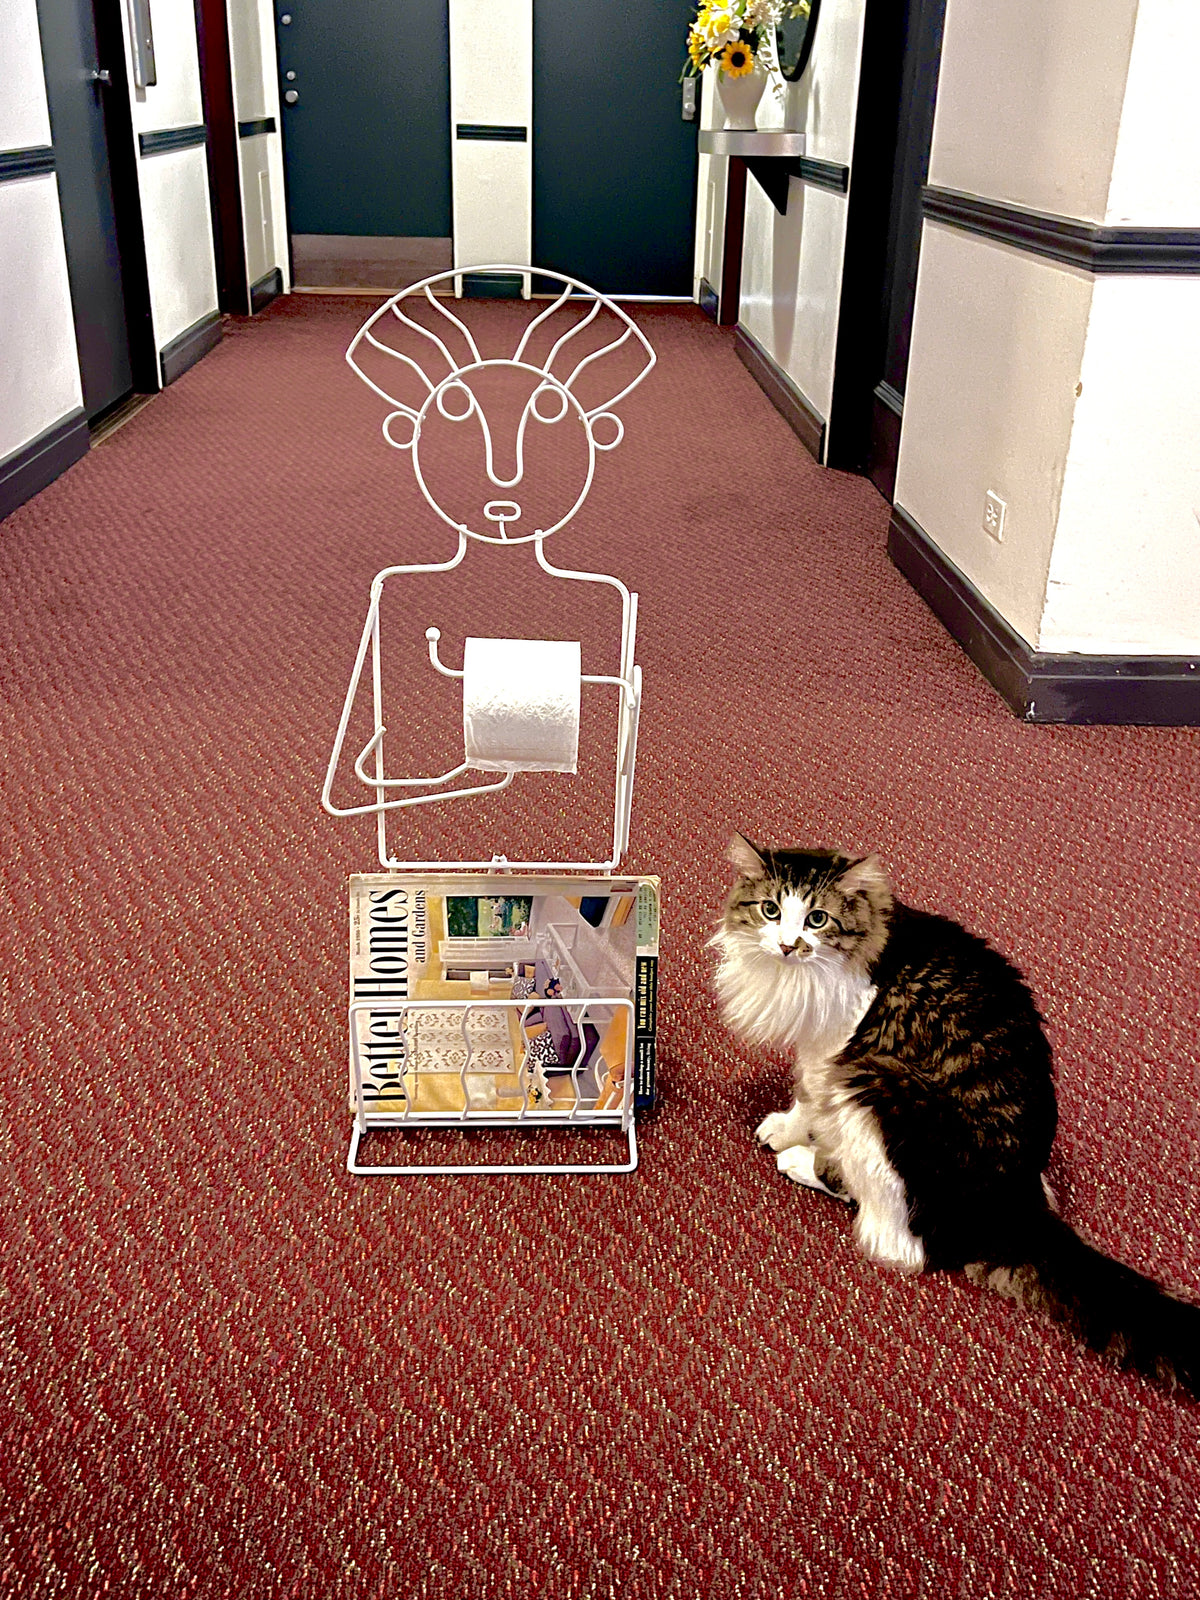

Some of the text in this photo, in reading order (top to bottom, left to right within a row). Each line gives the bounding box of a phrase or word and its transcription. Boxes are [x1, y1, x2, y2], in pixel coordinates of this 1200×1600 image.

[411, 889, 426, 964] and Gardens
[638, 973, 647, 985] and
[354, 889, 409, 1103] Better Homes
[637, 985, 647, 995] old
[638, 995, 647, 1006] mix
[639, 1006, 647, 1018] can
[637, 1018, 647, 1030] You
